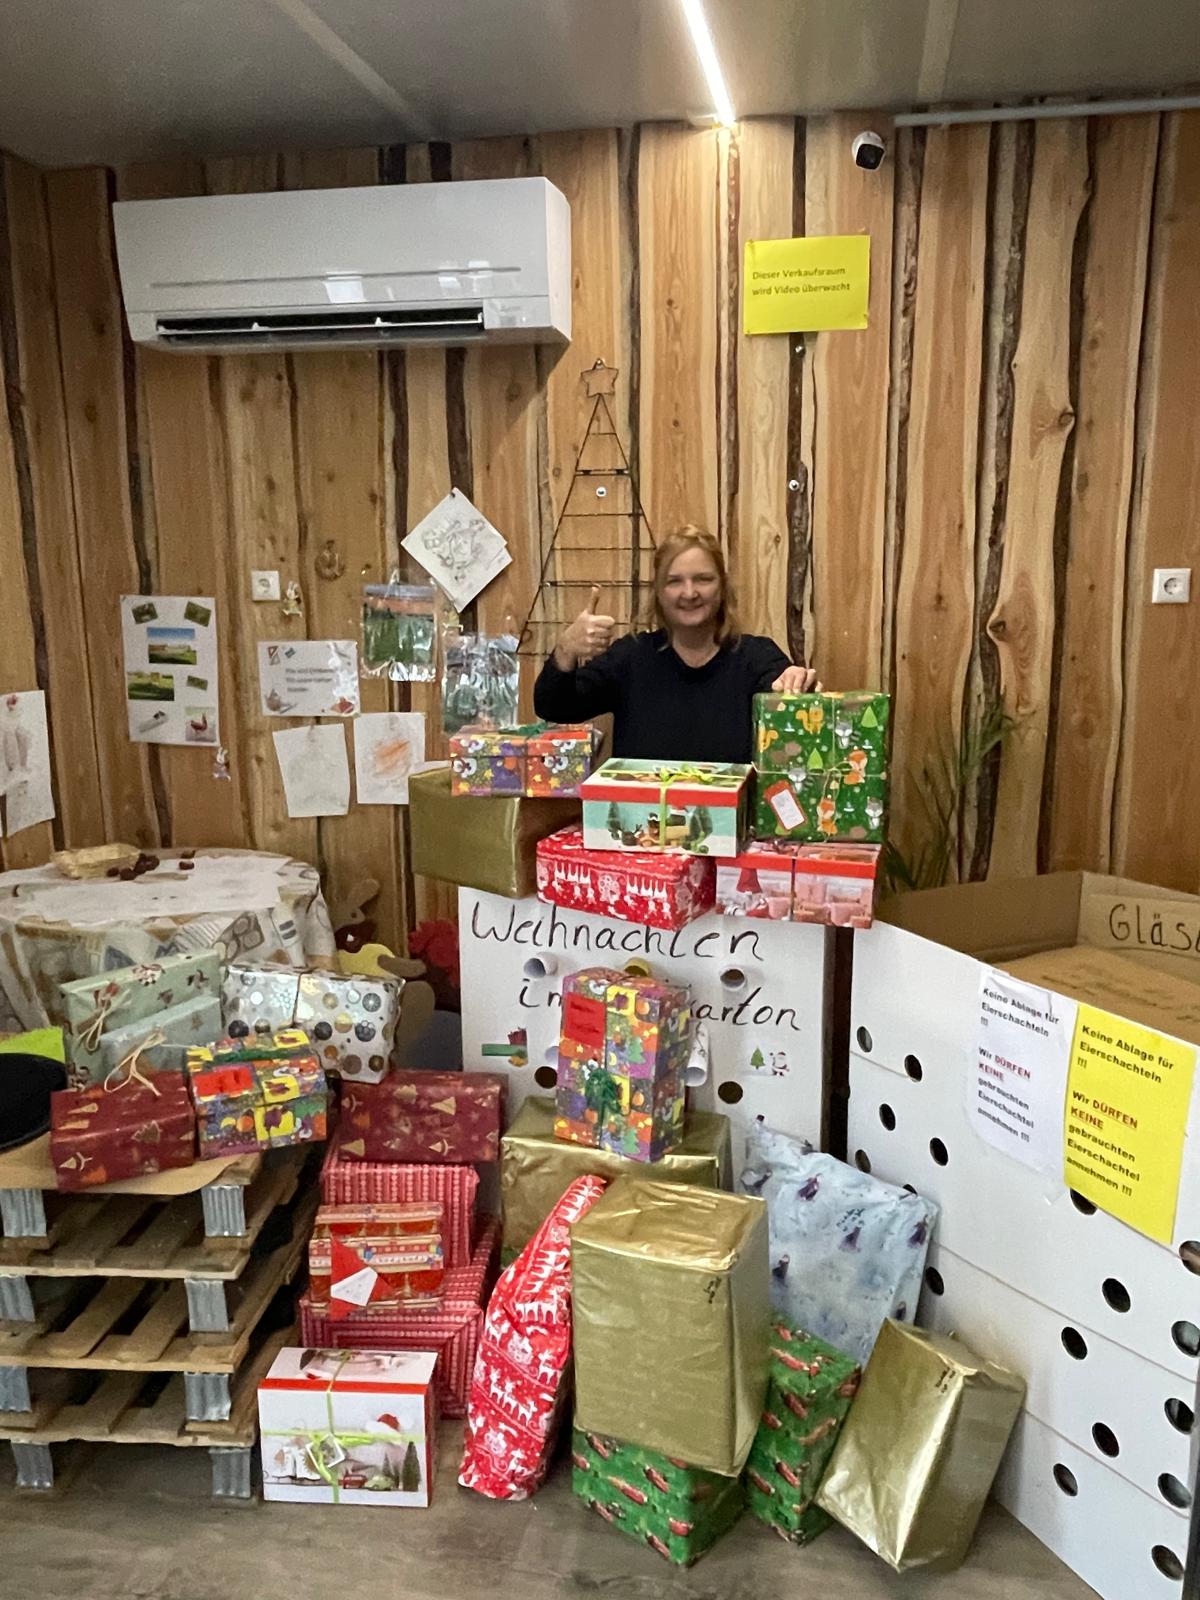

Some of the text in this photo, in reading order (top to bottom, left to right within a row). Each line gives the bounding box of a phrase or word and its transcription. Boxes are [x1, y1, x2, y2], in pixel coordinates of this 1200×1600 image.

[752, 267, 846, 280] Dieser Verkaufsraum
[752, 283, 850, 296] wird Video überwacht
[472, 901, 764, 961] Weihnachten
[690, 987, 801, 1031] arton
[981, 1002, 1049, 1037] Eierschachteln
[983, 987, 1009, 1004] Keine
[1011, 999, 1042, 1020] Ablage
[978, 1047, 1031, 1080] Wir DÜRFEN
[1079, 1041, 1162, 1084] Eierschachteln
[1082, 1025, 1174, 1071] Keine Ablage für
[978, 1062, 1004, 1082] KEINE
[978, 1077, 1029, 1110] gebrauchten
[978, 1090, 1034, 1128] Eierschachtel
[1072, 1090, 1138, 1129] Wir DÜRFEN
[977, 1107, 1019, 1137] annehmen
[1070, 1106, 1104, 1130] KEINE
[1067, 1138, 1141, 1182] Eierschachtel
[1068, 1124, 1136, 1163] gebrauchten
[1066, 1156, 1119, 1190] annehmen
